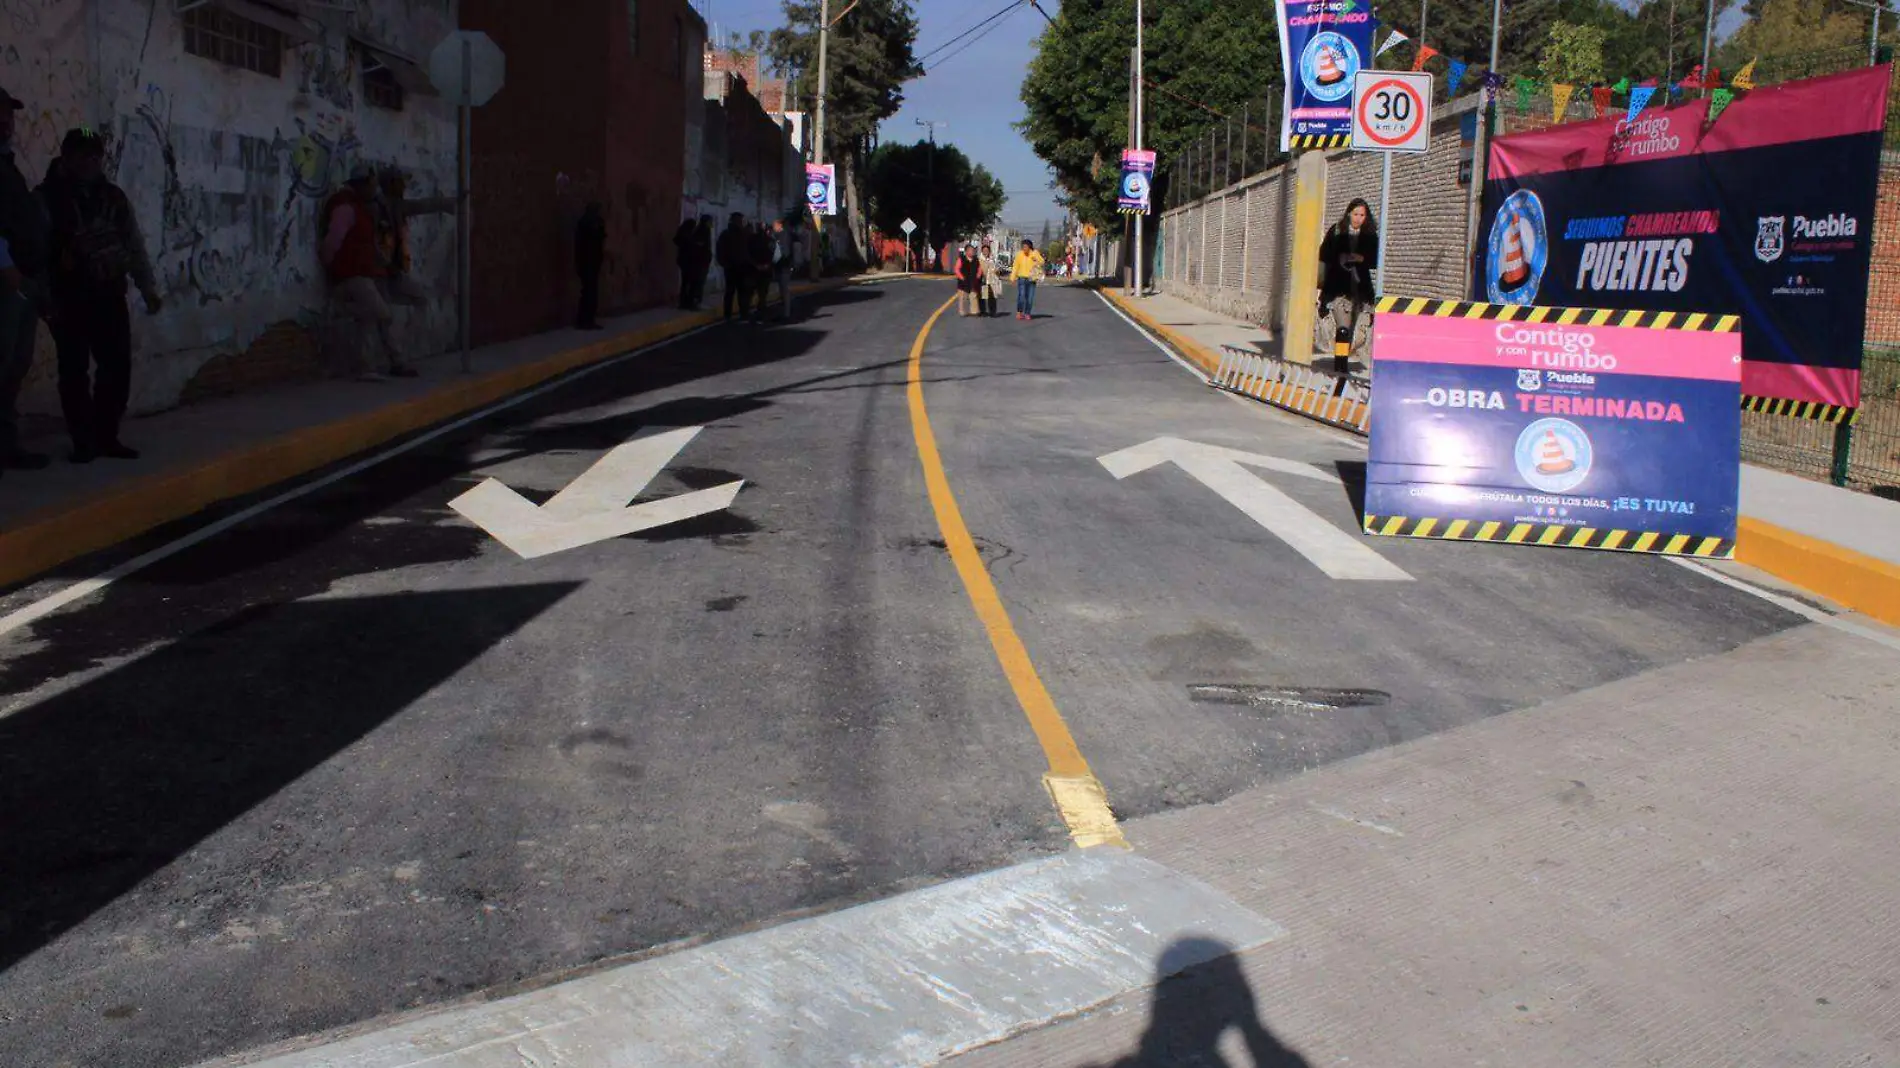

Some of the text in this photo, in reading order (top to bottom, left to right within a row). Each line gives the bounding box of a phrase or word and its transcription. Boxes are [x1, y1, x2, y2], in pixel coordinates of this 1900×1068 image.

[1374, 91, 1410, 121] 30
[1616, 114, 1670, 138] Contigo
[1631, 134, 1680, 156] rumbo
[1564, 210, 1721, 240] SEGUIMOS CHAMBEANDO
[1793, 213, 1857, 238] Puebla
[1575, 238, 1694, 292] PUENTES
[1495, 323, 1595, 353] Contigo
[1496, 346, 1617, 370] y con rumbo
[1547, 371, 1595, 384] Puebla
[1427, 387, 1685, 422] OBRA TERMINADA
[1527, 495, 1559, 505] TODOS
[1562, 496, 1581, 506] LOS
[1583, 498, 1610, 509] DÍAS,
[1613, 497, 1640, 512] ¡ES
[1644, 499, 1695, 514] TUYA!
